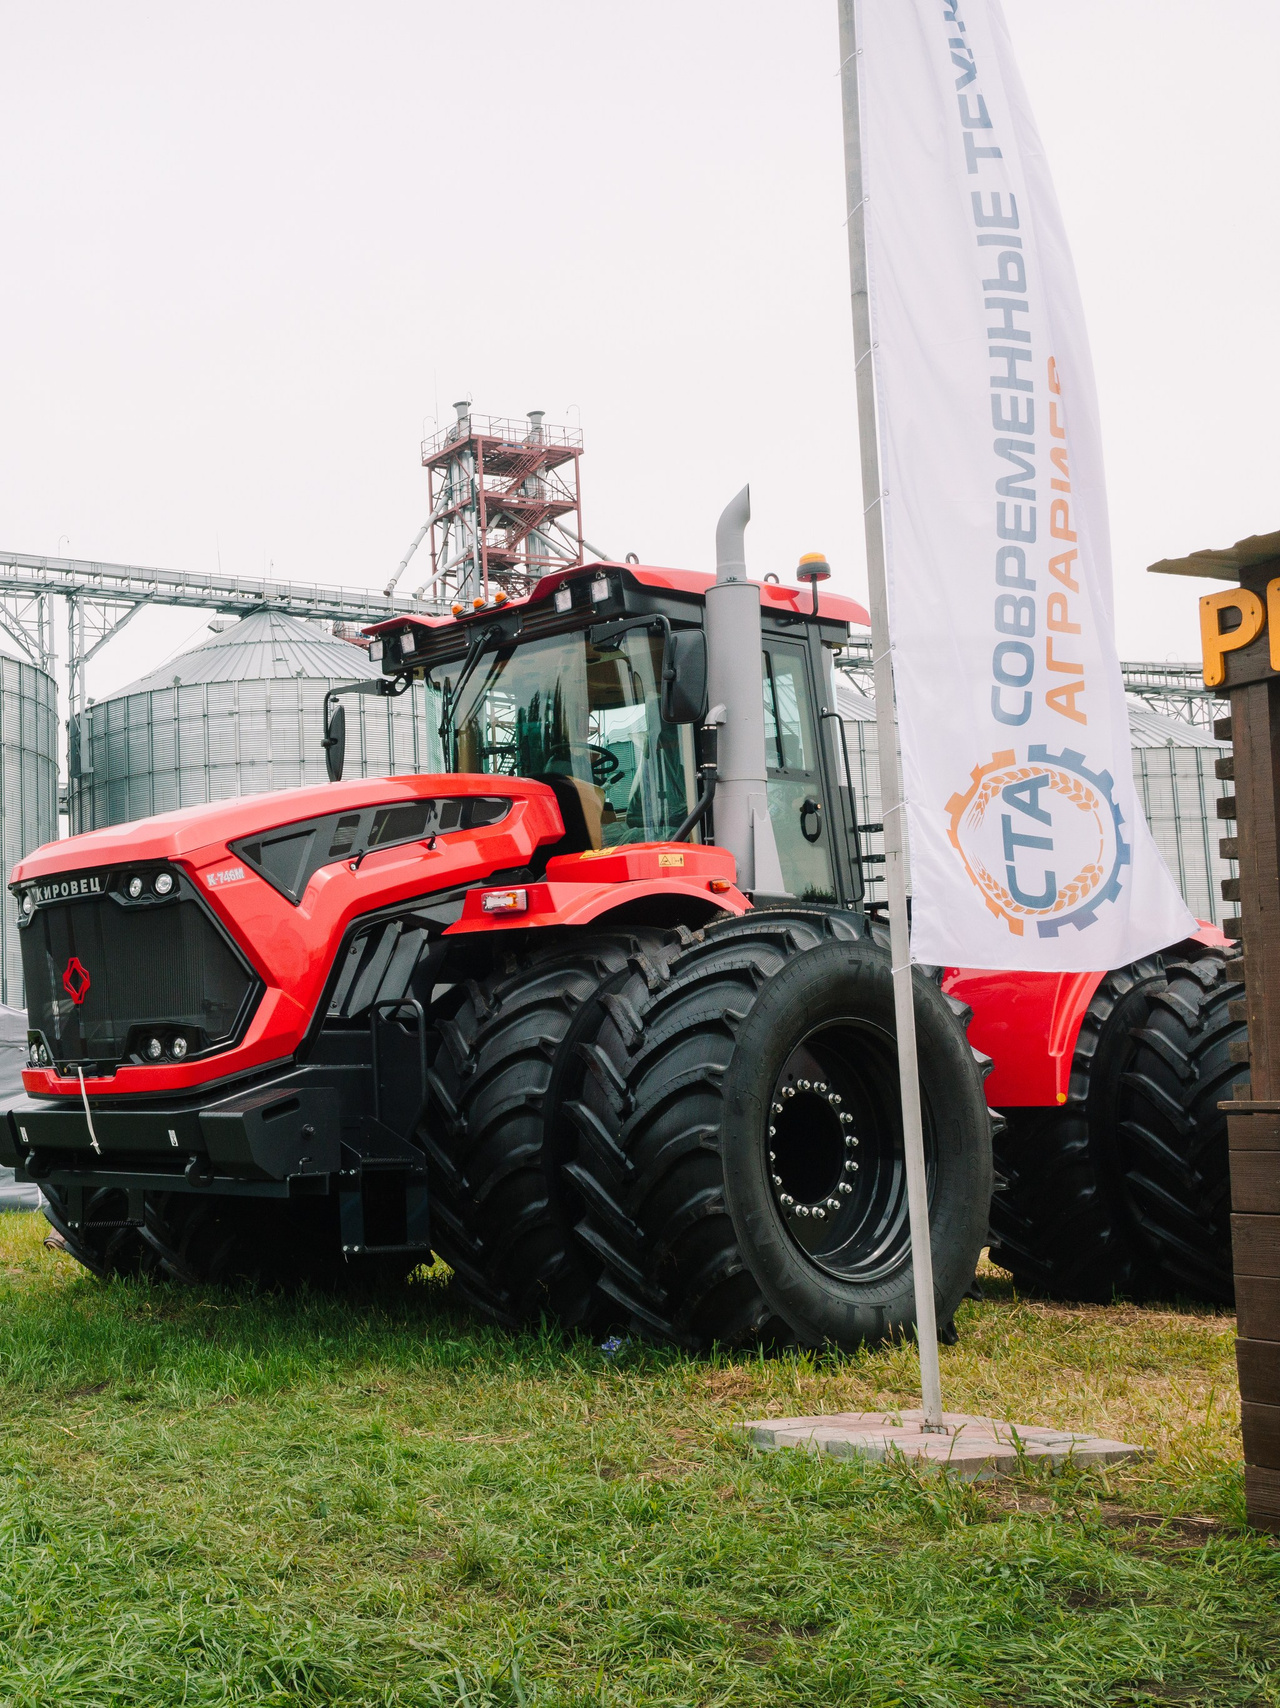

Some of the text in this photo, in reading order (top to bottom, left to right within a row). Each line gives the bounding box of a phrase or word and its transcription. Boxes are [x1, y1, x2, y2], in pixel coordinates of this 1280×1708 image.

[970, 190, 1037, 727] СОВРЕМЕННЫЕ
[36, 877, 101, 902] КИРОВЕЦ
[1001, 773, 1058, 910] СТА
